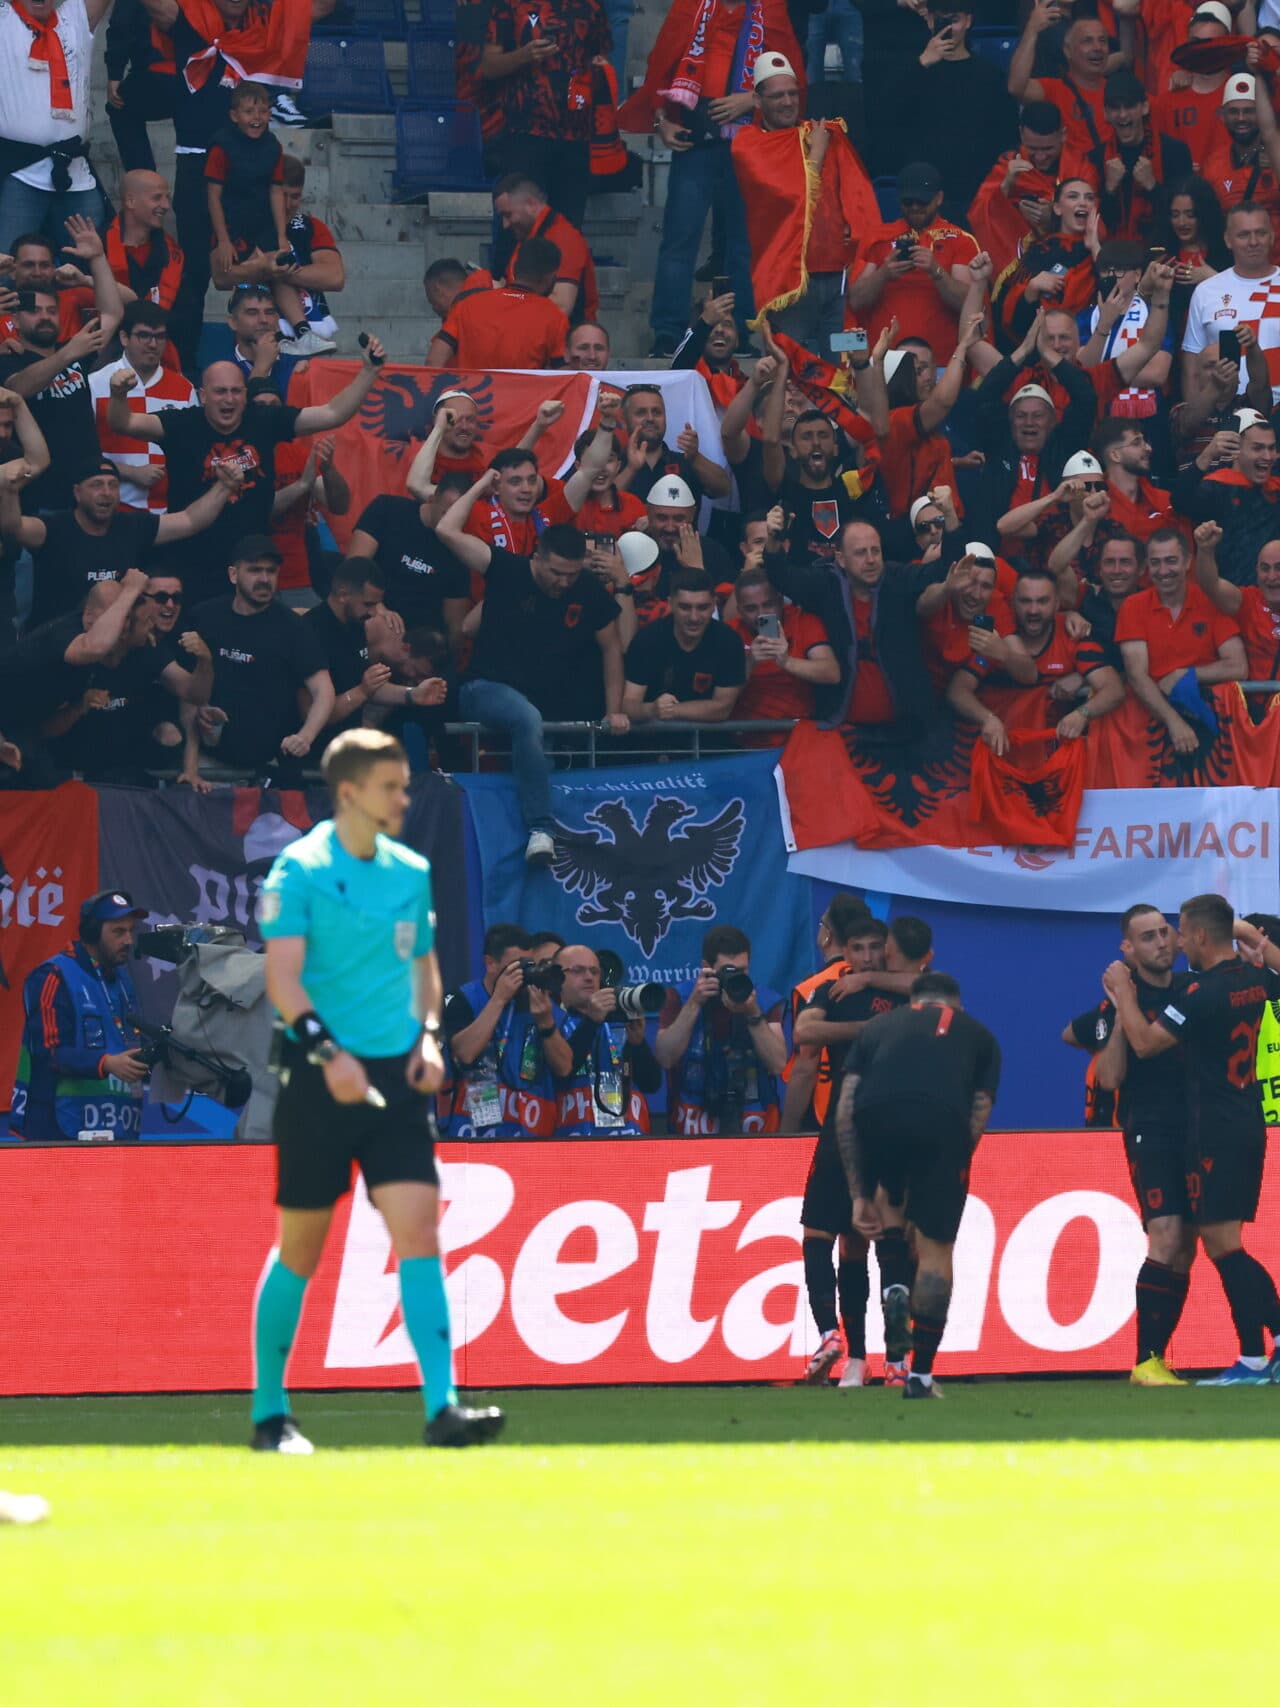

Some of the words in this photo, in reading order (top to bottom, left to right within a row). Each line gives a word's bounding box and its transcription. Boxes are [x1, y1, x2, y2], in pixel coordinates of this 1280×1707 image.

[1173, 105, 1198, 128] 10
[1068, 820, 1269, 860] FARMACI
[911, 1001, 955, 1037] 7
[324, 1160, 1149, 1369] Betano
